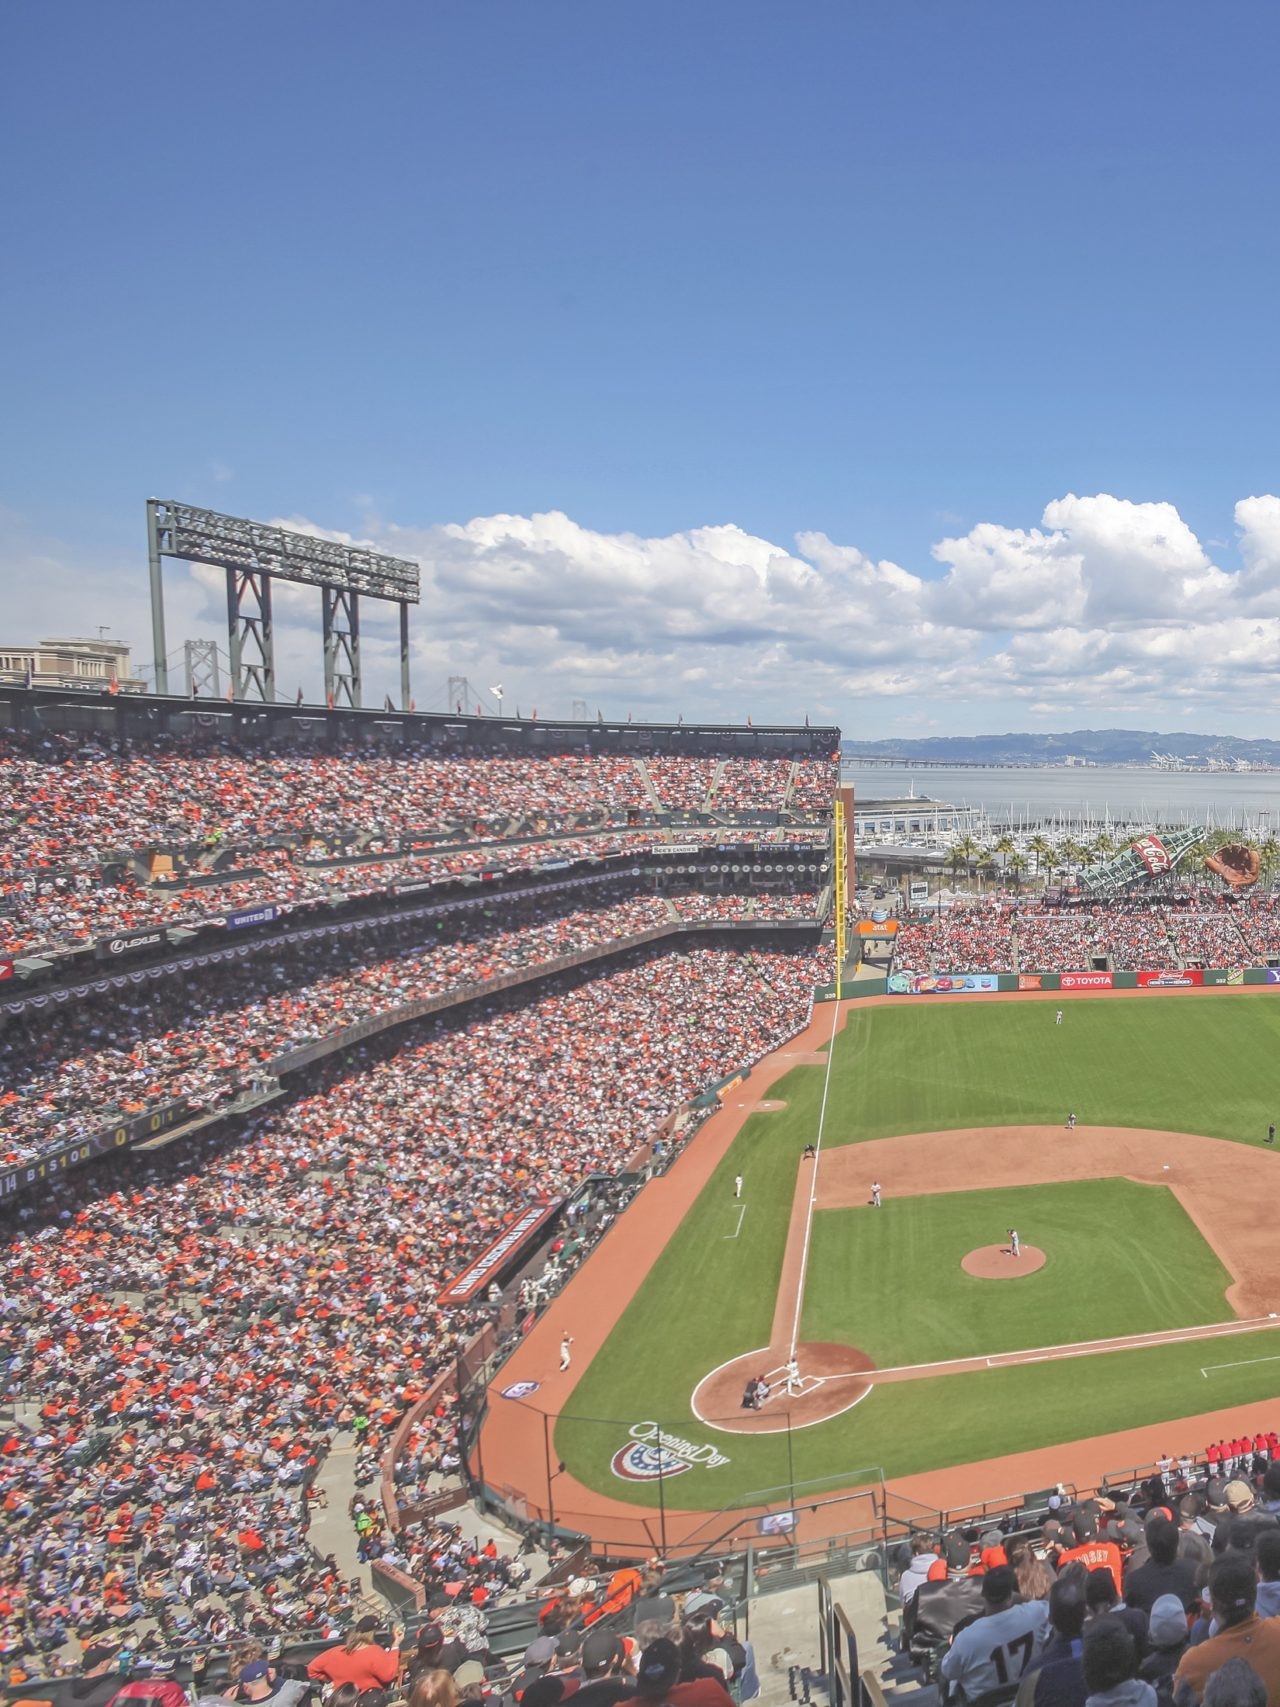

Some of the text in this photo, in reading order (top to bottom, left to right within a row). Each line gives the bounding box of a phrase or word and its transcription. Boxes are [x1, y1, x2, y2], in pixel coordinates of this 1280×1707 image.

[234, 913, 265, 926] UNITED
[124, 934, 161, 949] LEXUS
[1076, 976, 1112, 985] TOYOTA
[5, 1173, 17, 1193] 14
[27, 1168, 36, 1182] B
[39, 1164, 46, 1177] 1
[49, 1160, 57, 1171] S
[60, 1155, 67, 1168] 1
[628, 1421, 731, 1469] Opening Day
[990, 1631, 1034, 1683] 17
